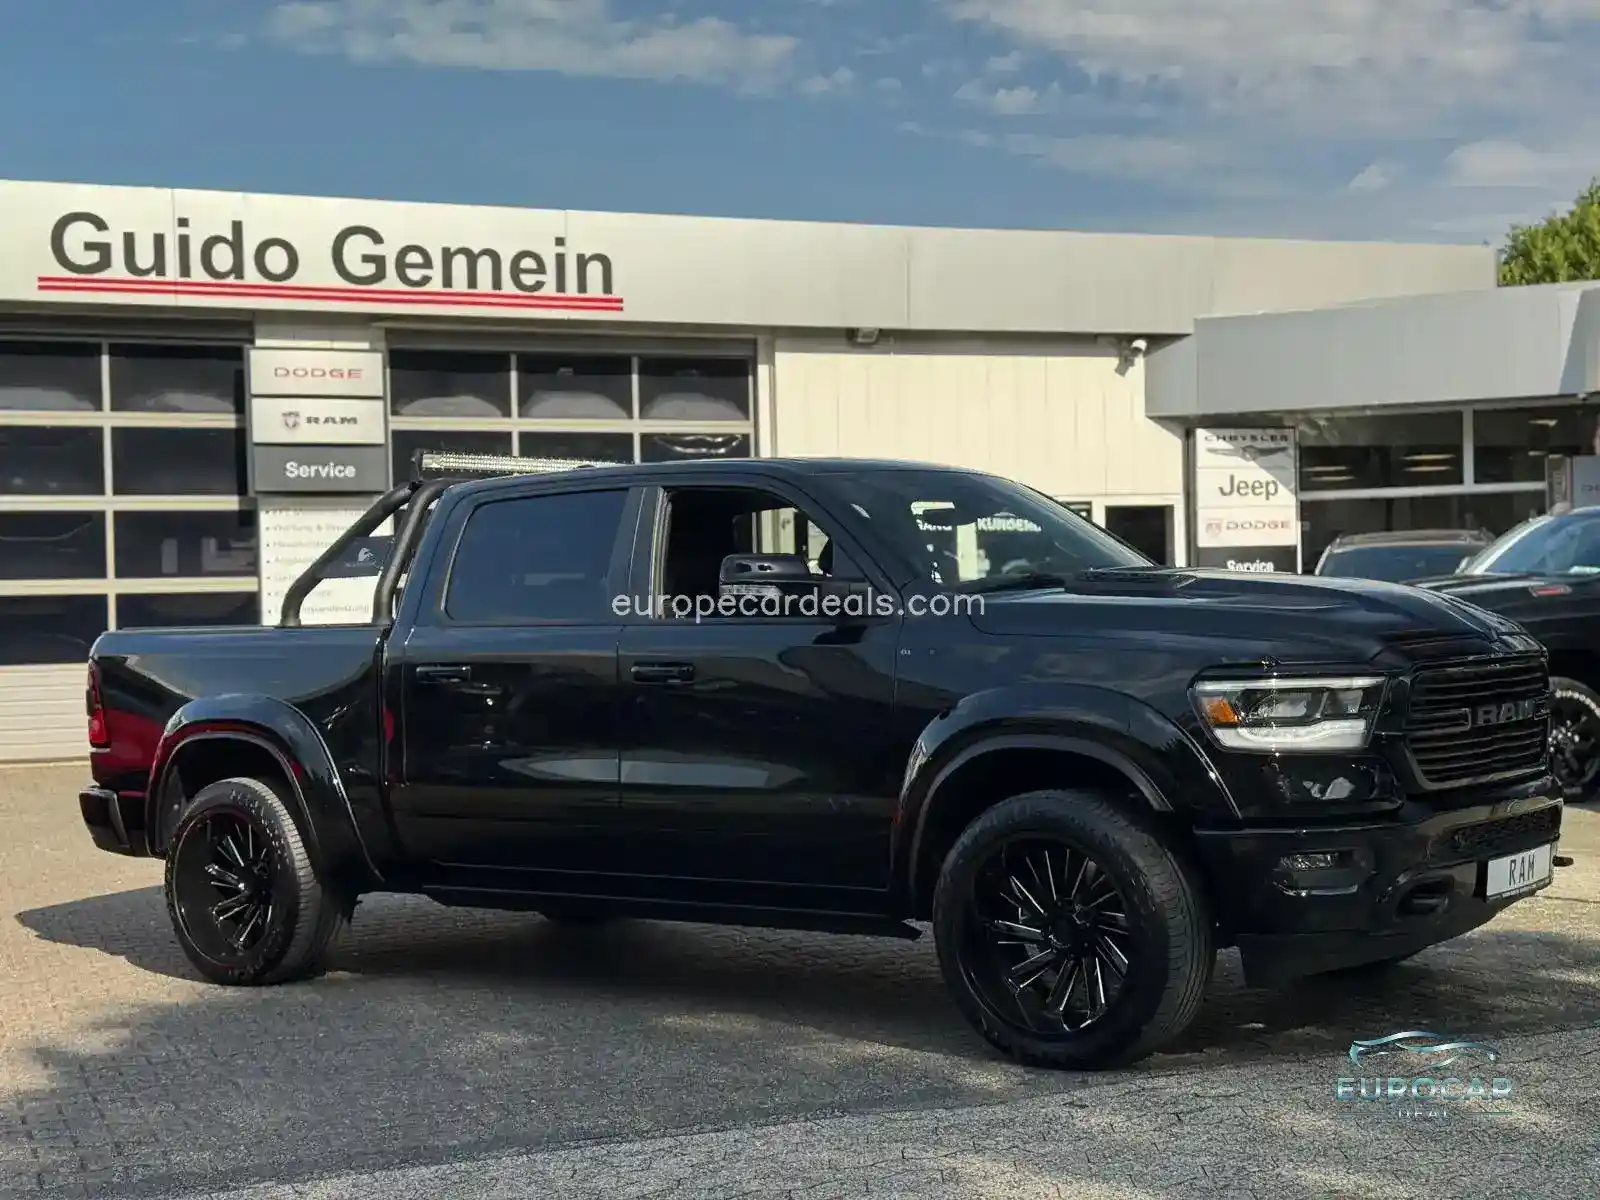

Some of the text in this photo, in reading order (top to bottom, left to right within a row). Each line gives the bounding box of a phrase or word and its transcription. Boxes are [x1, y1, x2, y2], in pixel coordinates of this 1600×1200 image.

[50, 211, 614, 295] Guido Gemein
[273, 366, 364, 379] DODGE
[306, 415, 359, 426] RAM
[1204, 434, 1289, 443] CHRYSLER
[285, 461, 357, 479] Service
[1218, 474, 1279, 501] Jeep
[1226, 519, 1291, 531] DODGE
[1227, 558, 1275, 573] Service
[1476, 699, 1535, 725] RAM
[1508, 854, 1536, 887] RAM
